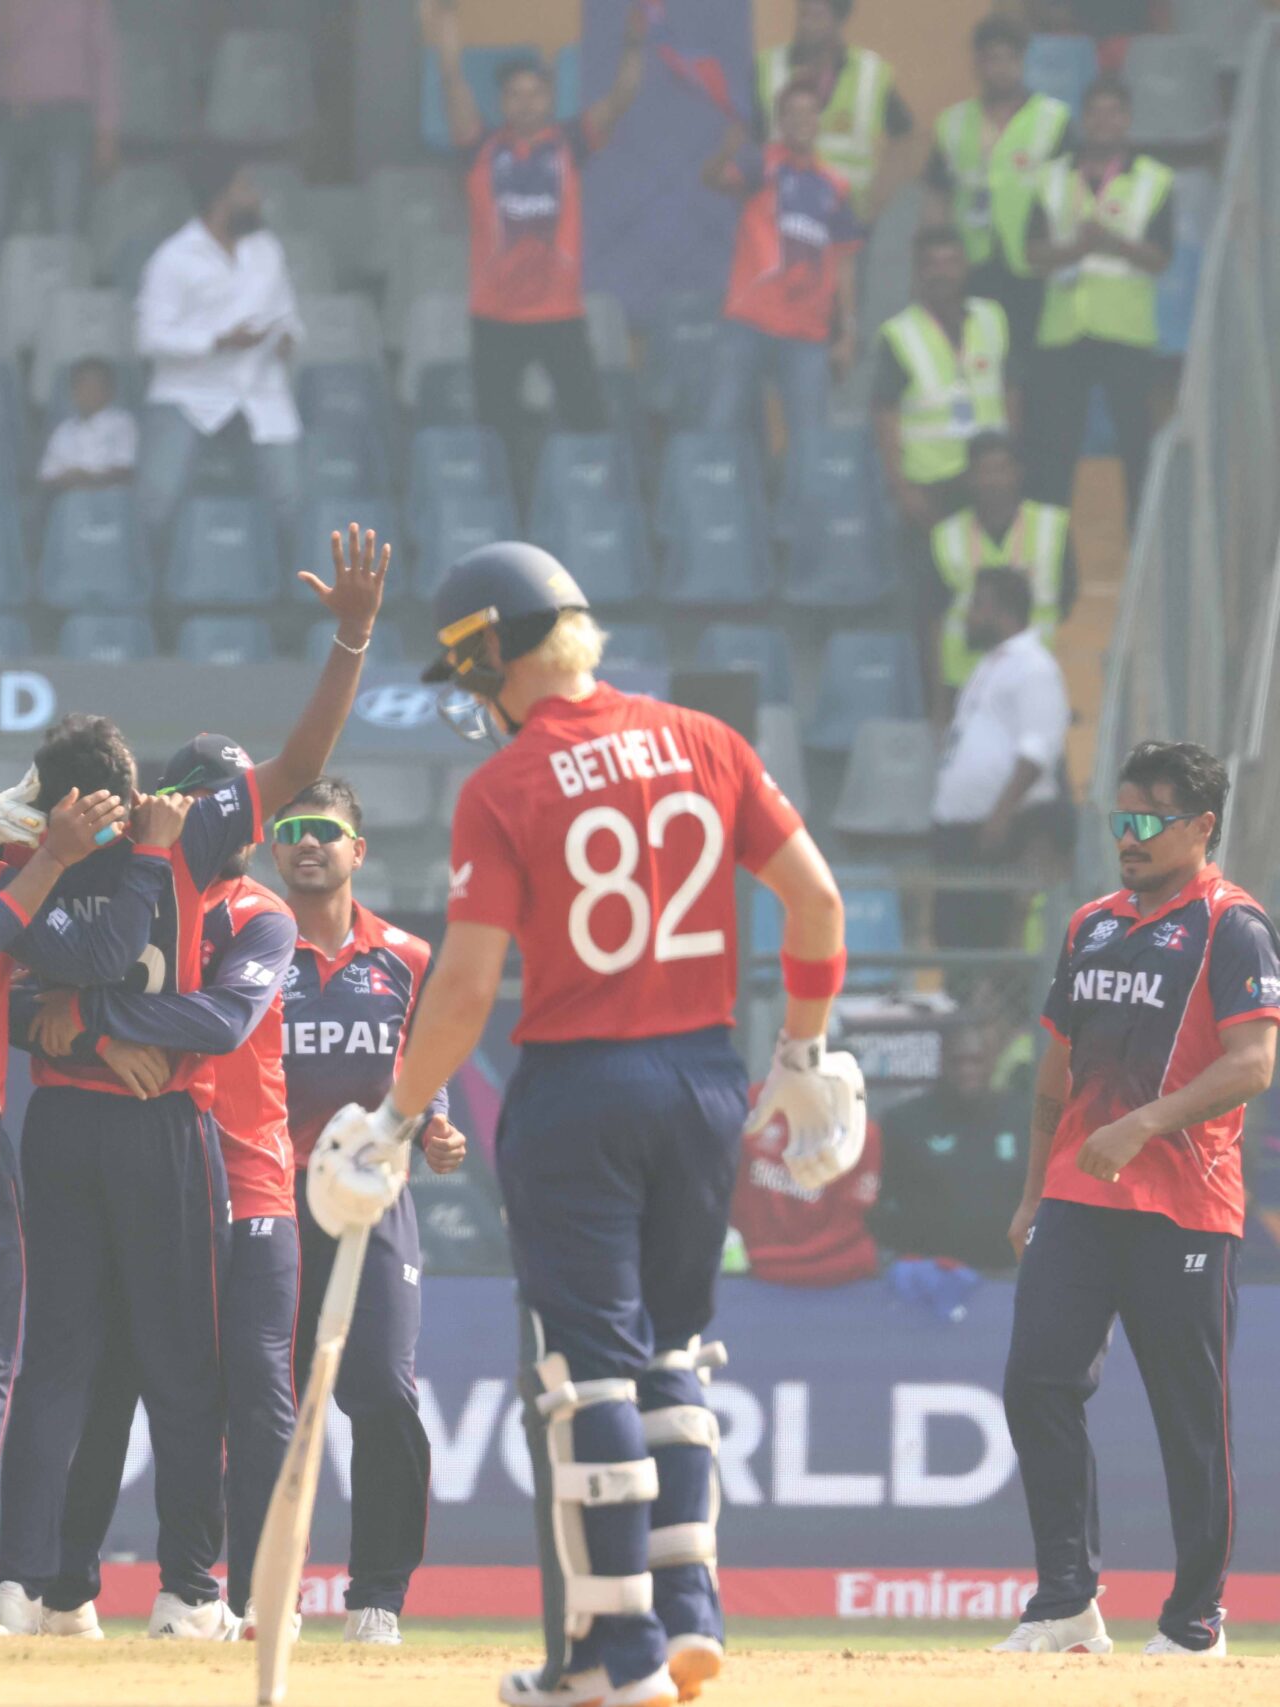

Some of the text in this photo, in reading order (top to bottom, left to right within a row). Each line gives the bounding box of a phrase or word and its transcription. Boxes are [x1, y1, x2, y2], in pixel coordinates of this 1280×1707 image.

[549, 726, 693, 798] BETHELL
[564, 790, 726, 975] 82
[1073, 969, 1165, 1009] NEPAL
[835, 1570, 1040, 1619] Emirat
